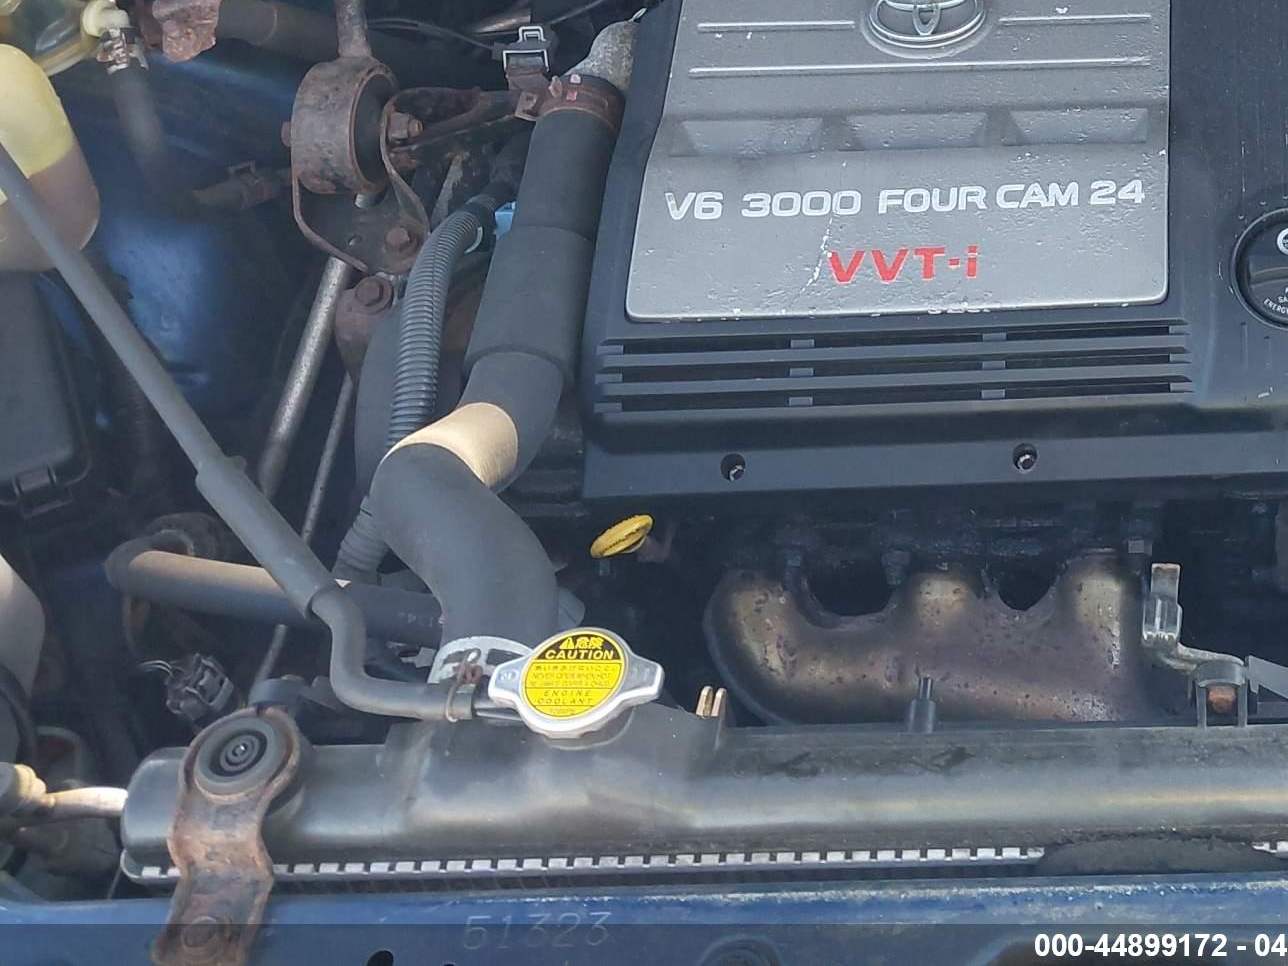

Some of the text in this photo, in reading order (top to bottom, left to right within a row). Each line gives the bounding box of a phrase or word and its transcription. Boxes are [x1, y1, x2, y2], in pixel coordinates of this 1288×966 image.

[665, 179, 1146, 221] V6 3000 FOUR CAM 24
[827, 244, 980, 284] VVT-i
[545, 649, 614, 660] CAUTION
[537, 697, 592, 705] COOLANT
[463, 912, 612, 950] 51323
